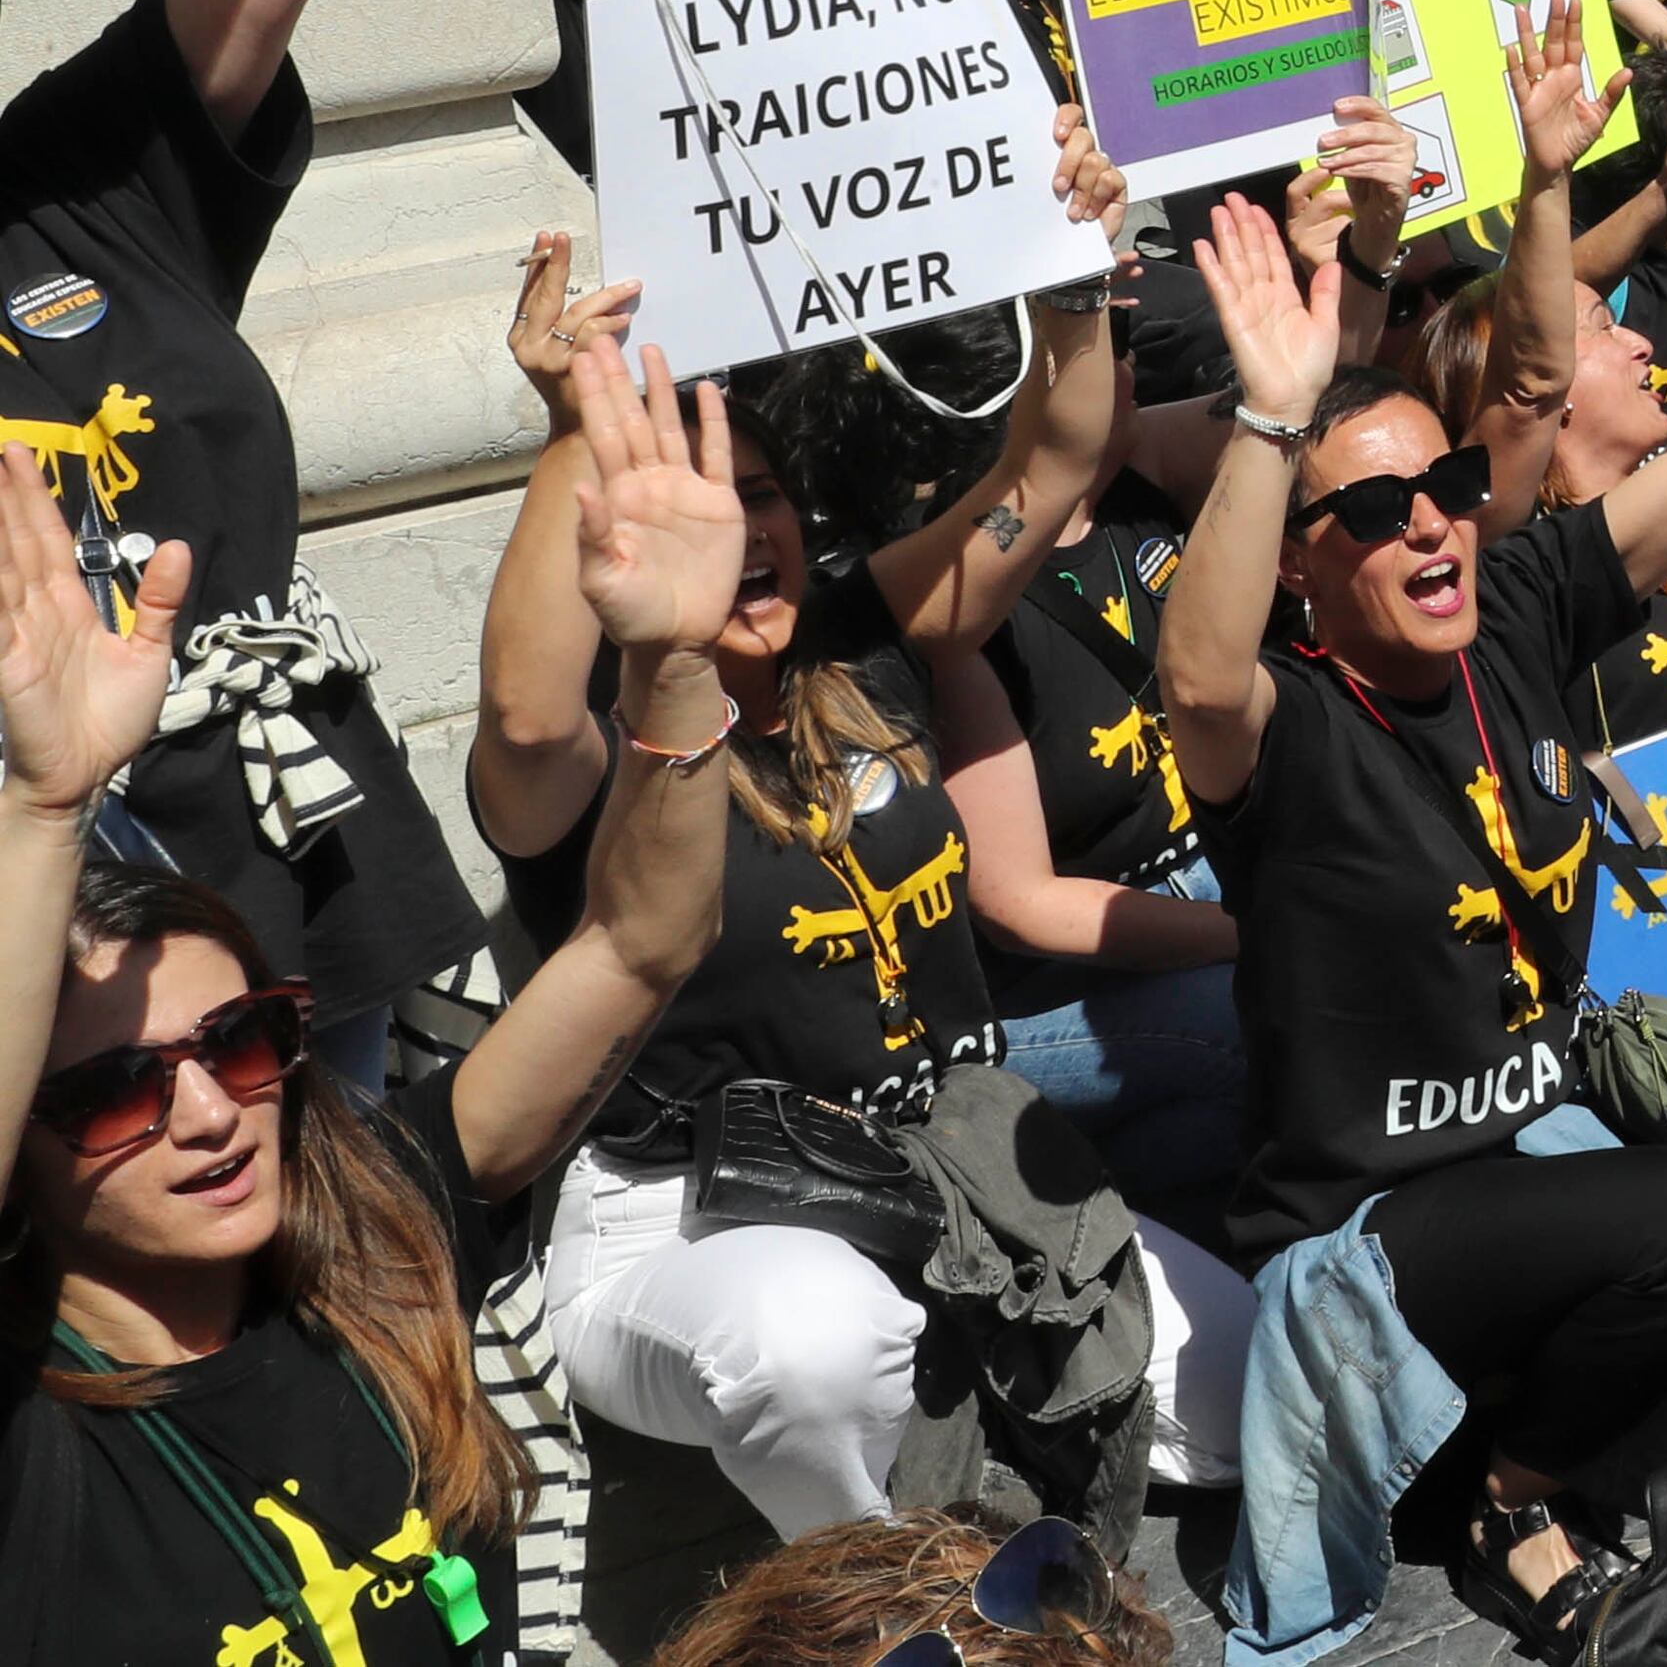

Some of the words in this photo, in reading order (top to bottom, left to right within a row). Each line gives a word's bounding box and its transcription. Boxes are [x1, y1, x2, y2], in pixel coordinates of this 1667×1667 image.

[659, 39, 1011, 162] TRAICIONES
[1153, 59, 1260, 102] HORARIOS
[1264, 55, 1276, 74] Y
[1279, 38, 1347, 72] SUELDO
[694, 189, 781, 255] TU
[801, 154, 931, 231] VOZ
[945, 135, 1015, 200] DE
[23, 287, 101, 328] EXISTEN
[794, 251, 957, 335] AYER
[1385, 1041, 1563, 1135] EDUCA
